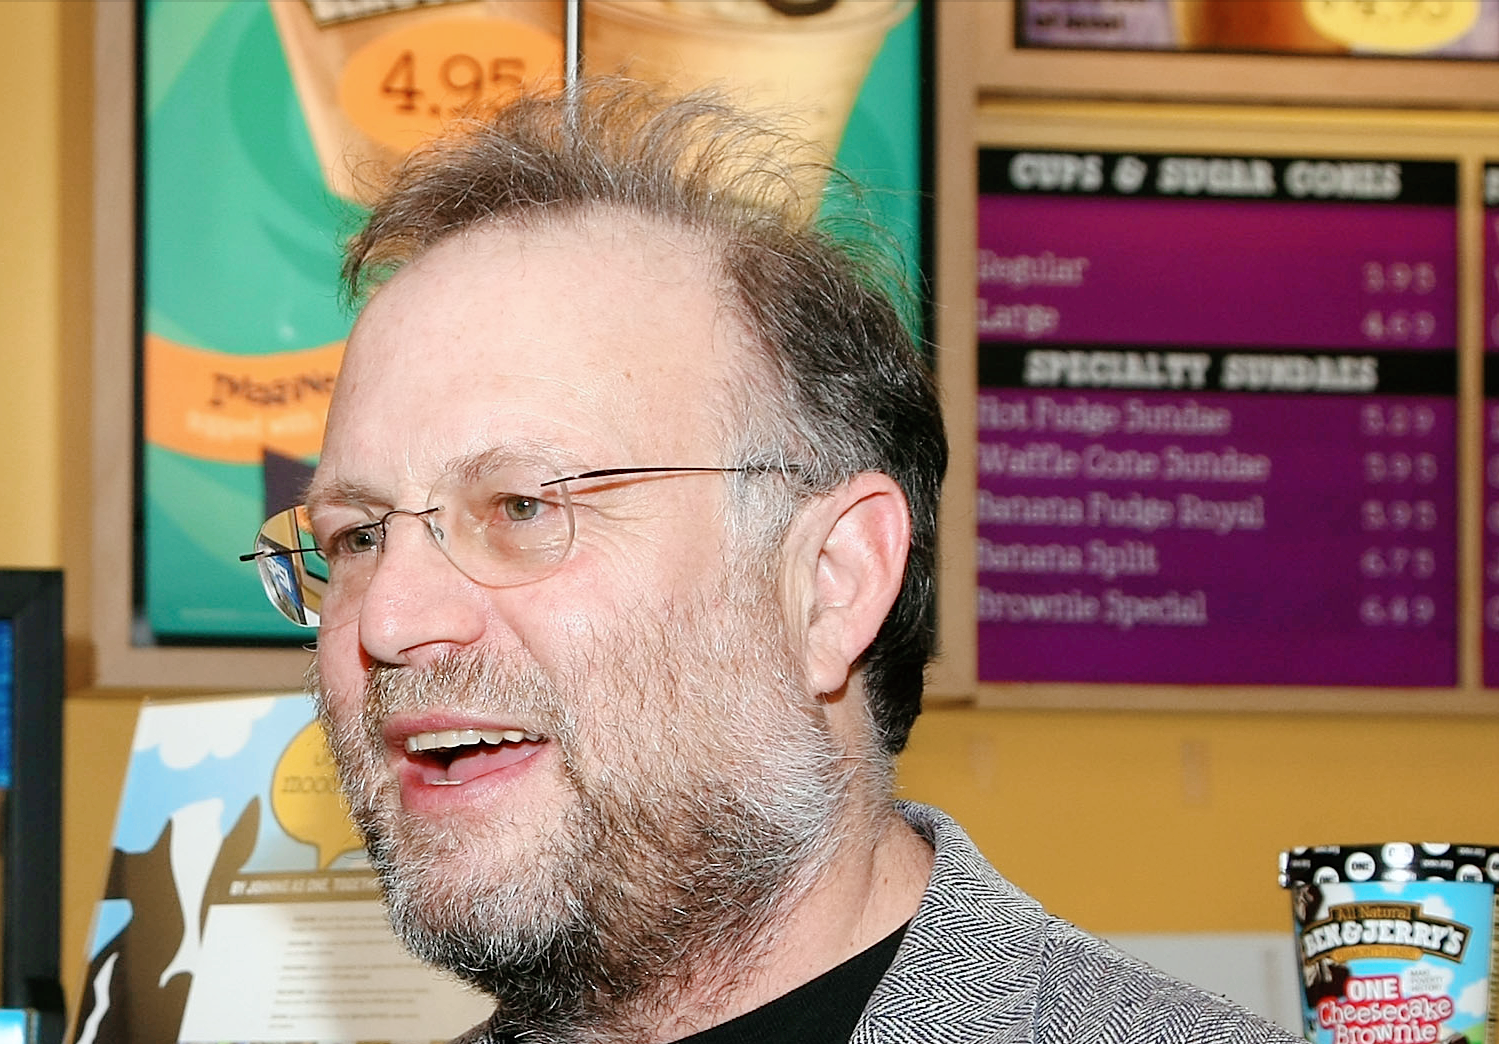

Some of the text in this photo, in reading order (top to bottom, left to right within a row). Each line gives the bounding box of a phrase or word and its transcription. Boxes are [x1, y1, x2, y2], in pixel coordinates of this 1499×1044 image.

[1010, 154, 1401, 199] CUPS & SUGAR CONES
[977, 250, 1090, 290] Regular
[977, 298, 1060, 338] Large
[1024, 350, 1378, 390] SPECIALTY SUNDAES
[977, 396, 1029, 432] Hot
[1033, 396, 1121, 436] Fudge
[1124, 399, 1232, 436] Sundae
[977, 442, 1081, 479] Waffle
[1084, 444, 1160, 480] Cone
[1162, 446, 1271, 482] Sundae
[977, 489, 1084, 526] Banana
[1087, 492, 1175, 532] Fudge
[1178, 495, 1265, 535] Royal
[977, 537, 1083, 575] Banana
[1086, 538, 1159, 581] Split
[977, 587, 1100, 624] Brownie
[1102, 589, 1207, 631] Special
[1360, 905, 1411, 920] Natural
[1347, 977, 1399, 1000] ONE
[1319, 998, 1452, 1026] Cheesecake
